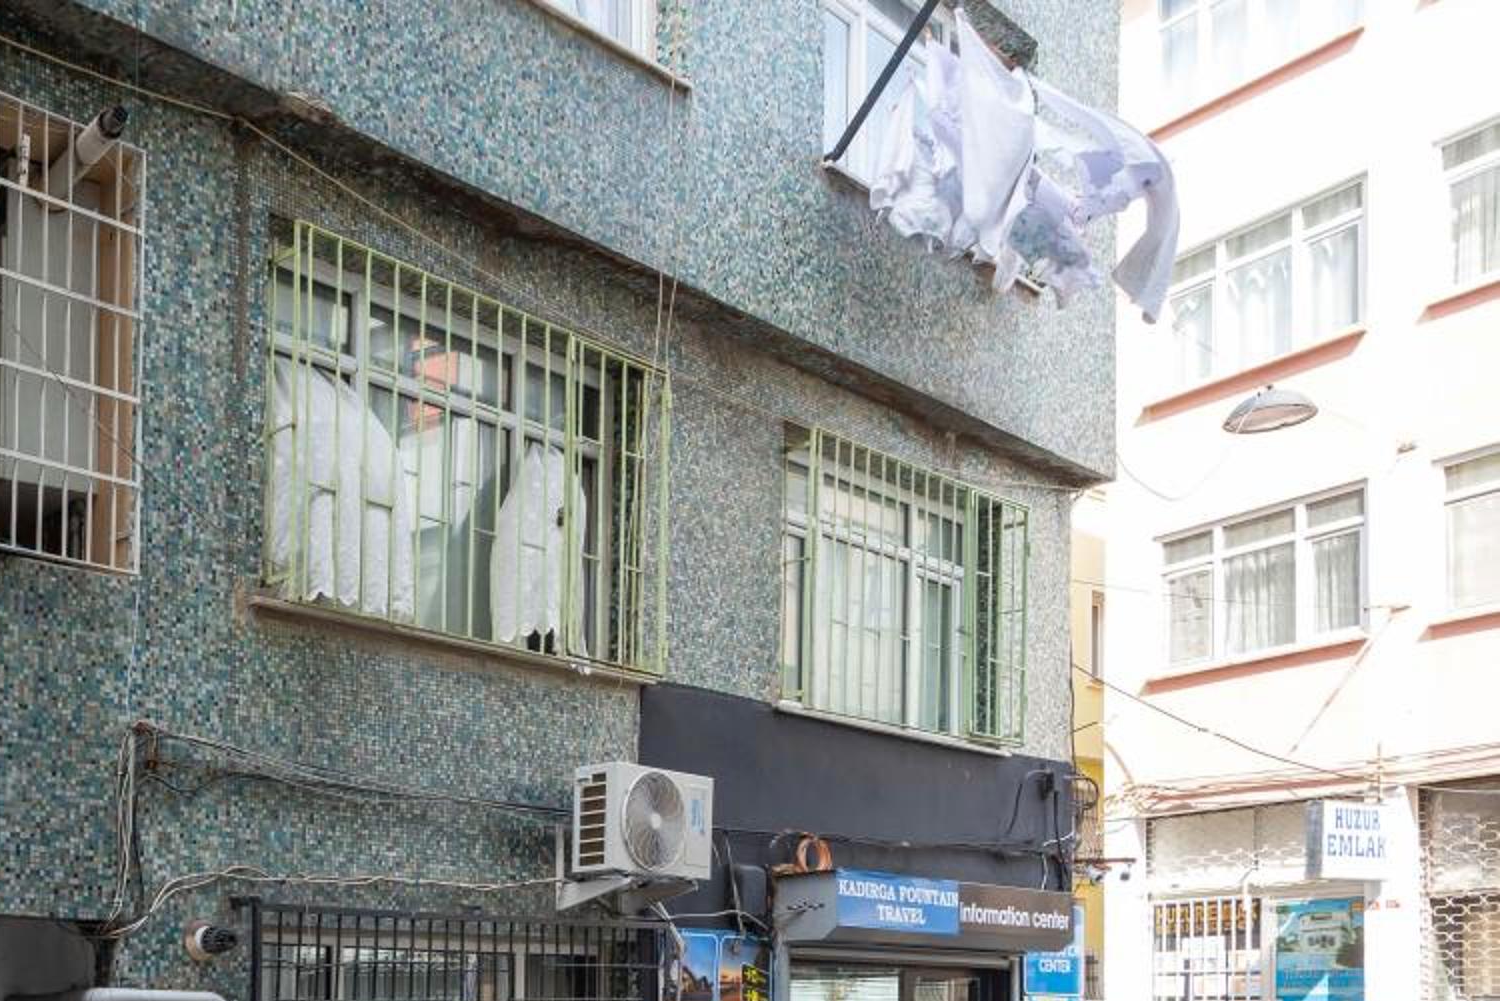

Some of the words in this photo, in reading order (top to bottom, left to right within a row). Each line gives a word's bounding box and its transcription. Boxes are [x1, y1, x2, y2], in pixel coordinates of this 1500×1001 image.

[1335, 807, 1381, 830] HUZUR
[1327, 833, 1387, 858] EMLAK
[838, 879, 897, 900] KADIRGA
[899, 885, 959, 907] FOUNTAIN
[877, 904, 927, 925] TRAVEL
[1032, 910, 1070, 930] center
[1039, 960, 1071, 973] CENTER
